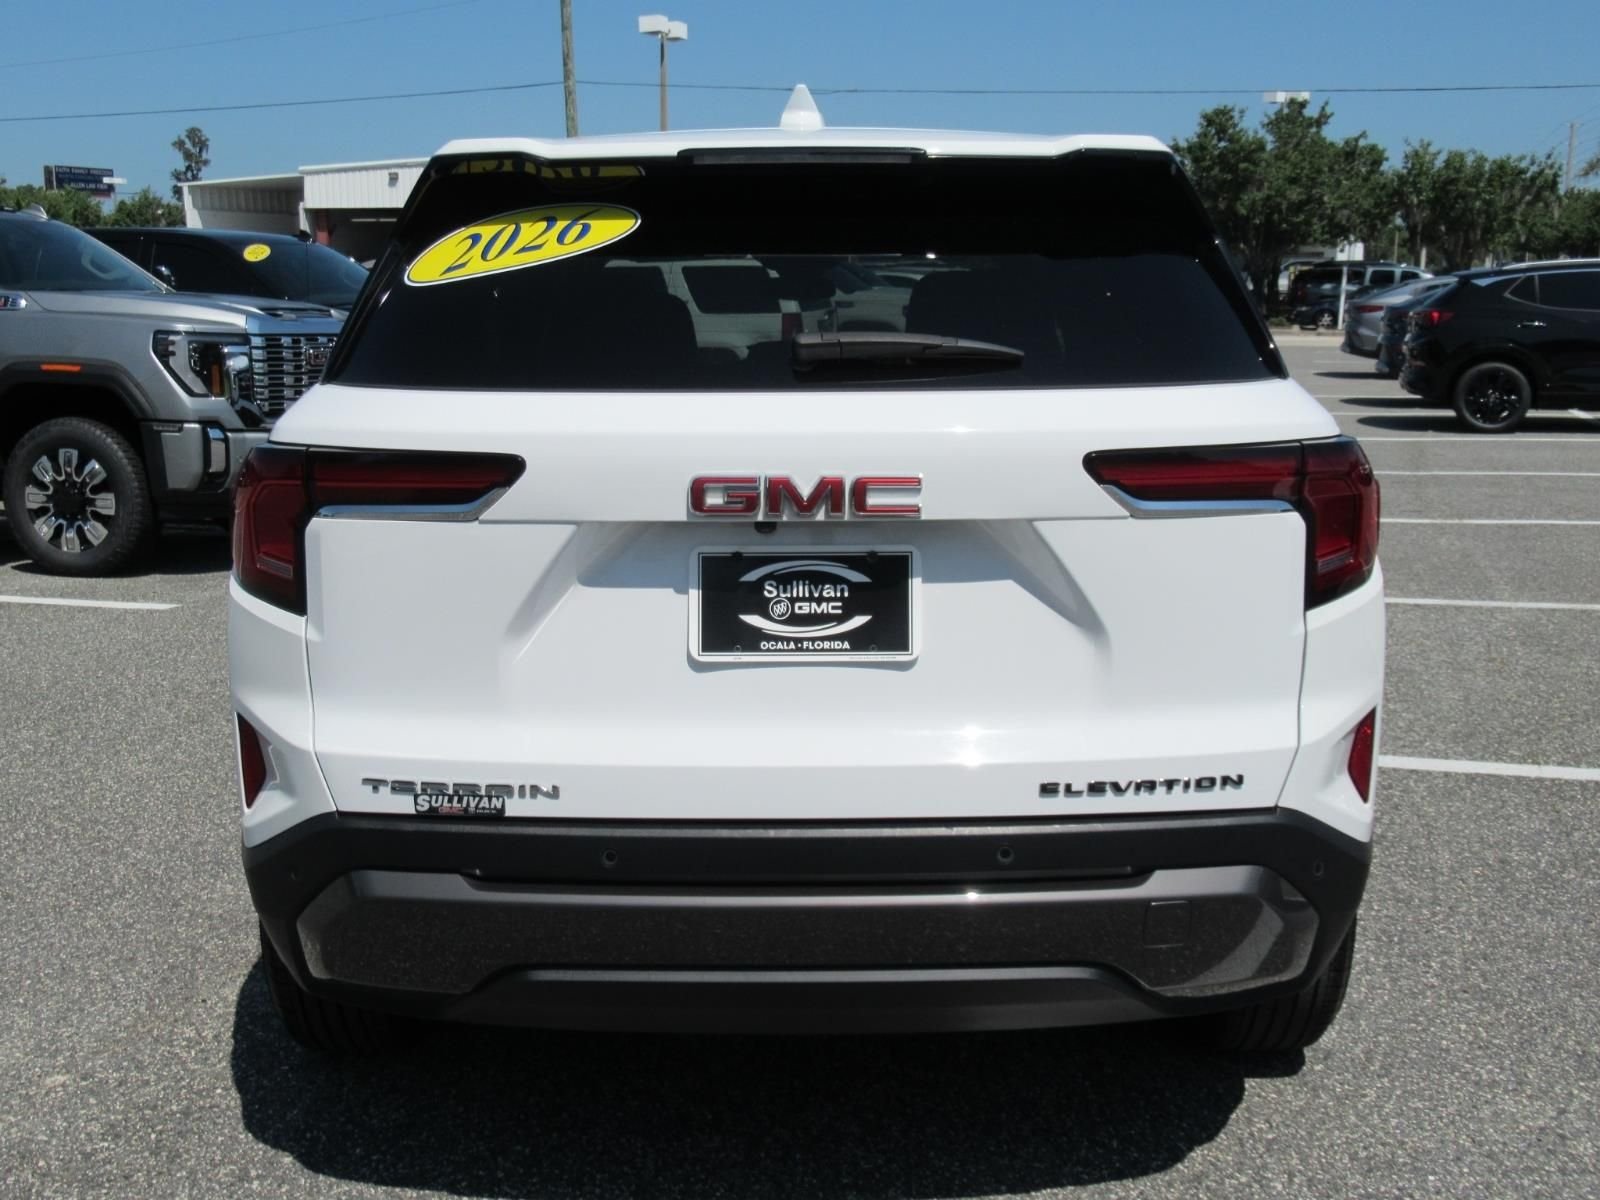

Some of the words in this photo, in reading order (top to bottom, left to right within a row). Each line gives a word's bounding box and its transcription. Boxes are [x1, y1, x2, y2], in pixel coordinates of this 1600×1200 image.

[439, 207, 606, 277] 2026
[689, 474, 923, 518] GMC
[763, 580, 849, 598] Sullivan
[794, 602, 843, 614] GMC
[760, 641, 796, 650] OCALA
[803, 641, 850, 650] FLORIDA
[1039, 773, 1245, 798] ELEVATION
[415, 794, 504, 812] SULLIVAN
